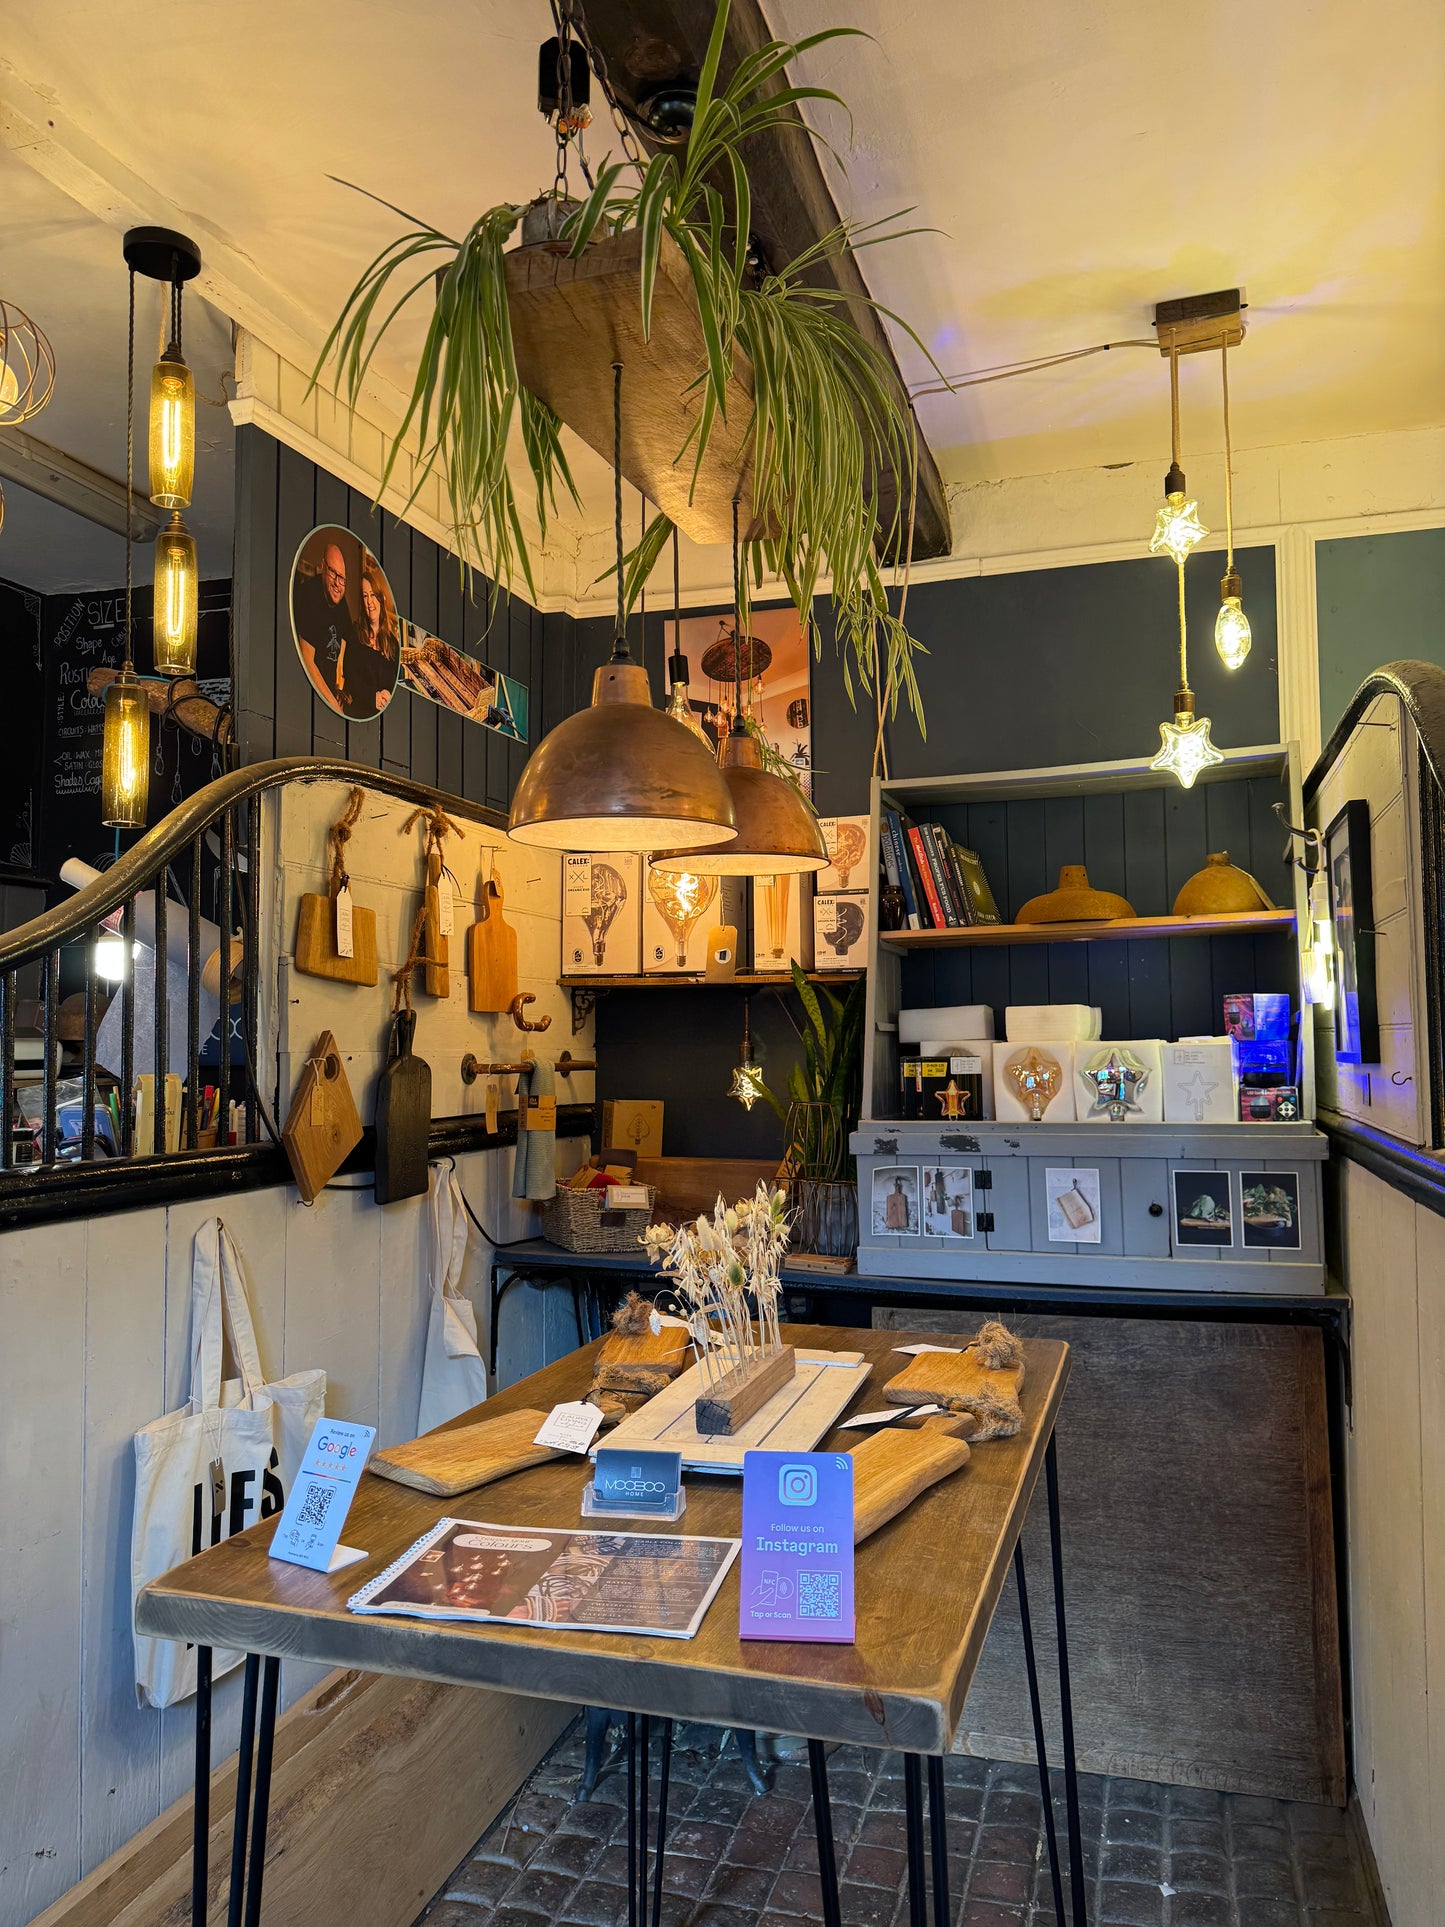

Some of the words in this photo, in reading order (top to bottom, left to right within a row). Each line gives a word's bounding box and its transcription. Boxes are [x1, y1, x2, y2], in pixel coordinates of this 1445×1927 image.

[87, 597, 128, 625] SIZE
[54, 598, 85, 648] POSITION
[75, 636, 103, 655] Shape
[101, 650, 117, 669] Age
[76, 750, 91, 760] WAX
[881, 833, 895, 870] potatoes
[890, 829, 901, 857] chinese
[567, 858, 590, 866] CALEX
[569, 870, 589, 884] XXL
[943, 895, 953, 913] FOOD
[317, 1436, 357, 1459] Google
[605, 1479, 665, 1493] MOOBOO
[770, 1523, 798, 1533] Follow
[800, 1525, 811, 1533] us
[812, 1525, 825, 1533] on
[468, 1538, 533, 1550] Colours
[756, 1536, 839, 1557] Instagram
[764, 1578, 776, 1586] NFC
[751, 1610, 764, 1620] Tap
[765, 1611, 773, 1619] or
[773, 1611, 792, 1620] Scan
